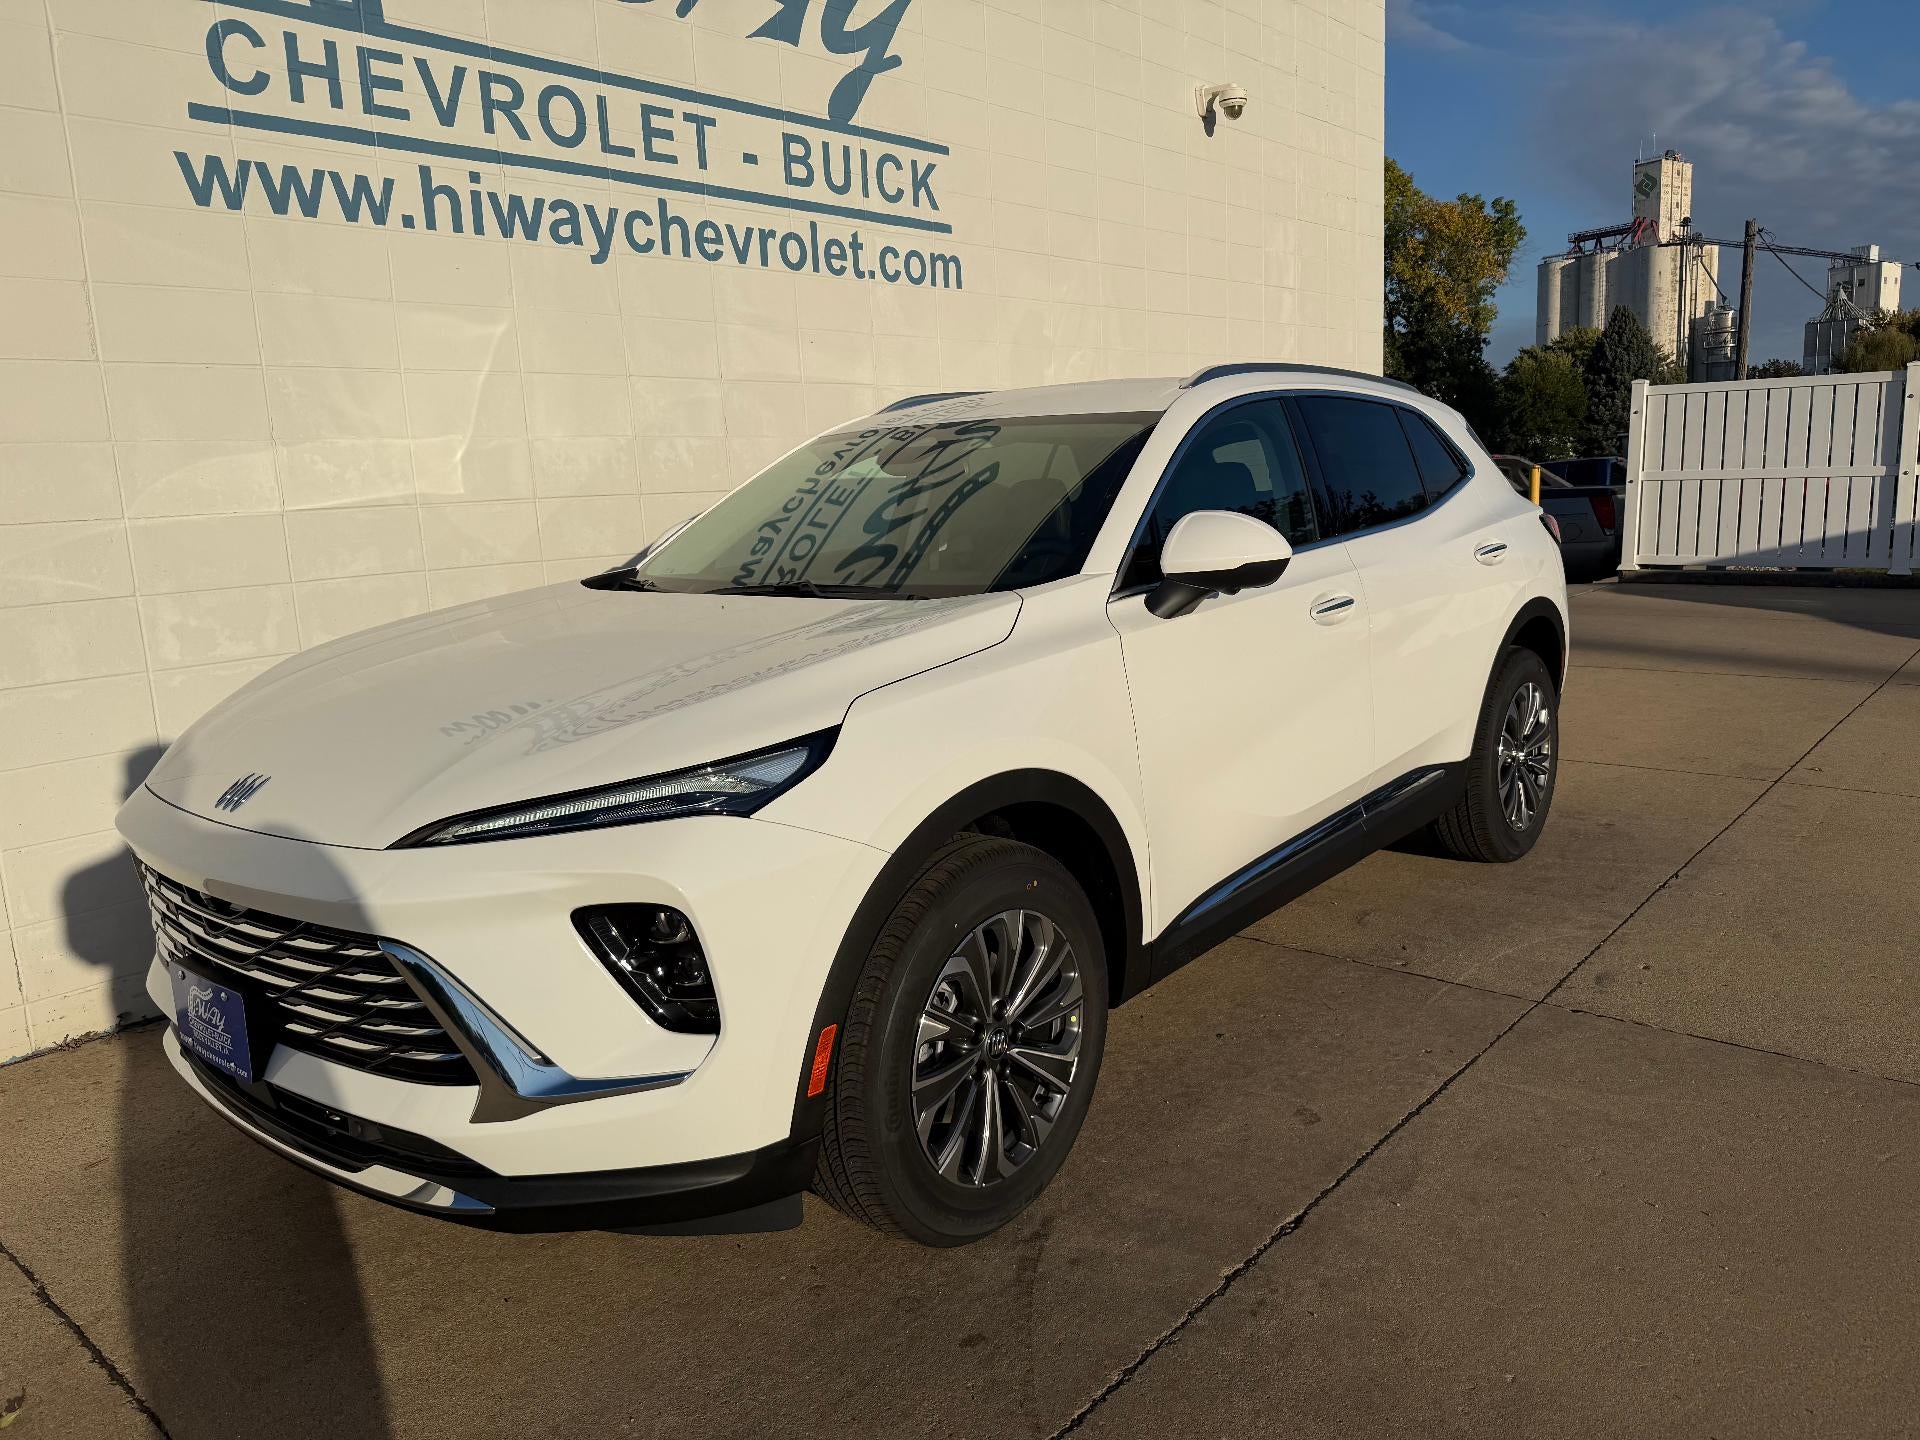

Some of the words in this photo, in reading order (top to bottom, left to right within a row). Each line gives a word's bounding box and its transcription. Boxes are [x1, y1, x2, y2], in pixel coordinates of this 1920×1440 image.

[206, 18, 716, 170] CHEVROLET
[782, 131, 940, 211] BUICK
[173, 150, 963, 289] www.hiwaychevrolet.com
